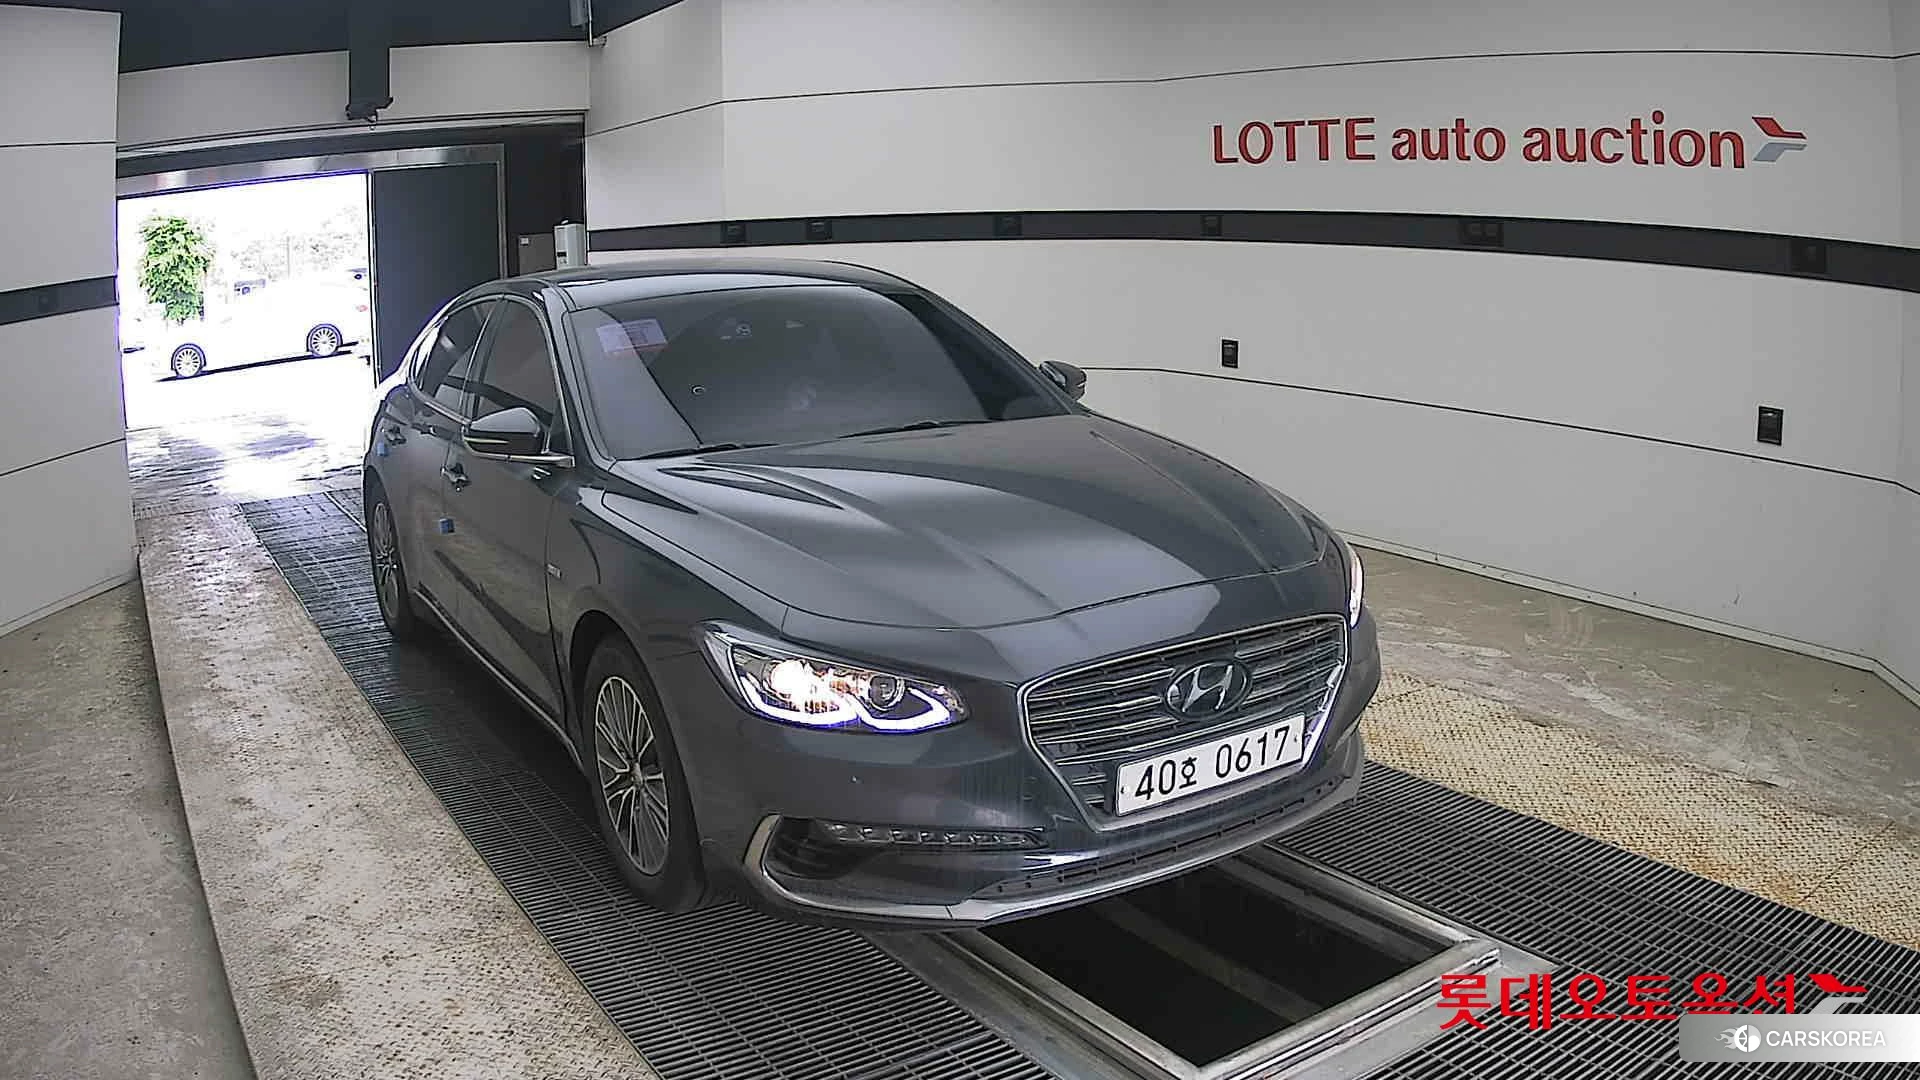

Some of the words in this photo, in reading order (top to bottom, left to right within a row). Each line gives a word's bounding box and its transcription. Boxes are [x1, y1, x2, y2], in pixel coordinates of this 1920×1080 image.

[1212, 118, 1377, 164] LOTTE
[1391, 118, 1506, 161] auto
[1523, 110, 1746, 169] auction
[1135, 757, 1198, 800] 40호
[1215, 725, 1291, 778] 0617
